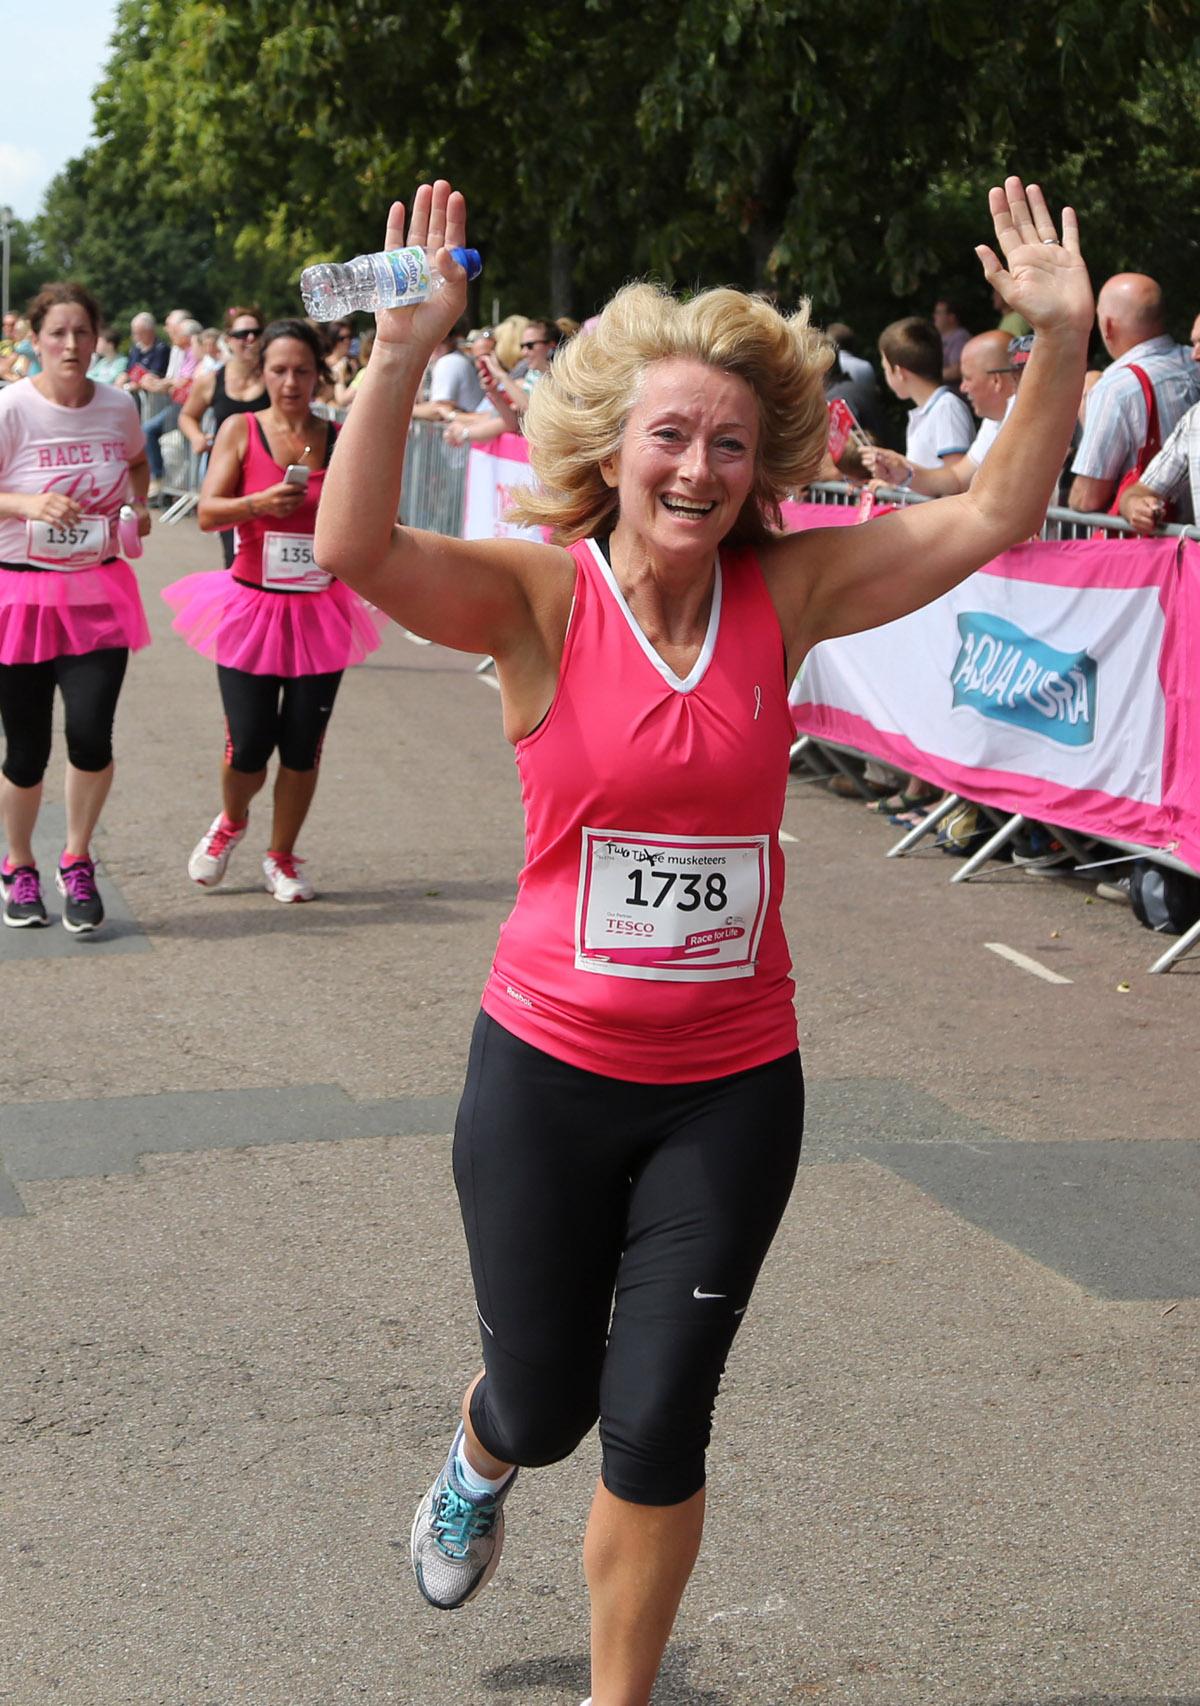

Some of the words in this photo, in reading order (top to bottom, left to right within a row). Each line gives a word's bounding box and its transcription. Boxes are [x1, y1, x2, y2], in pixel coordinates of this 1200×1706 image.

[402, 254, 418, 286] Buxton
[38, 444, 93, 468] RACE
[47, 528, 89, 545] 1357
[281, 547, 315, 564] 135
[606, 842, 630, 857] Two
[667, 855, 727, 866] musketeers
[626, 869, 728, 912] 1738
[606, 918, 654, 933] TESCO
[690, 934, 713, 946] Race
[714, 931, 724, 940] for
[725, 928, 739, 937] Life
